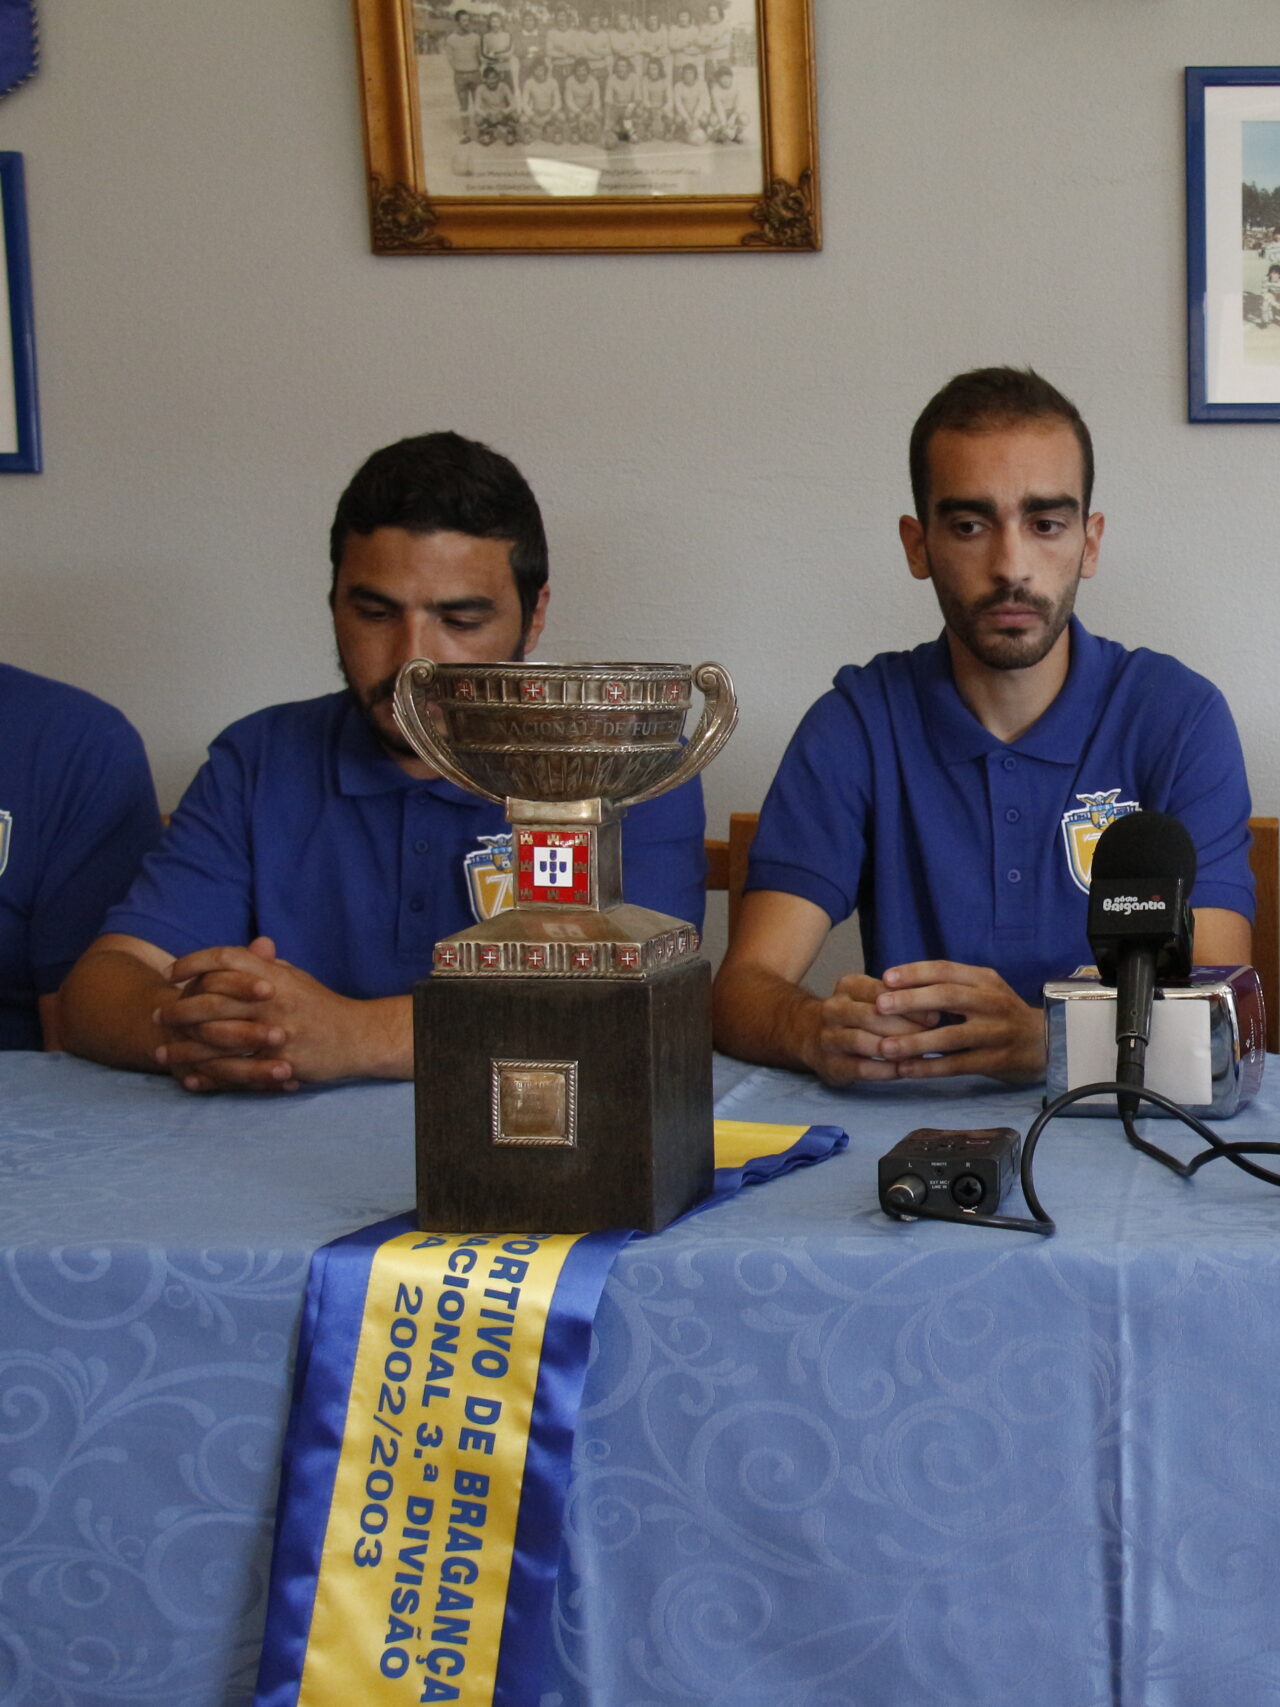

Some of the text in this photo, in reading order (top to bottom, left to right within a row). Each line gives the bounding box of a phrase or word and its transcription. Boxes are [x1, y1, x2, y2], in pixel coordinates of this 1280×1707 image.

[496, 719, 595, 737] NACIONAL
[602, 721, 624, 736] DE
[353, 1282, 424, 1568] 2002/2003
[458, 1395, 503, 1456] DE
[379, 1495, 435, 1679] DIVISÃO
[416, 1469, 490, 1703] BRAGANÇA
